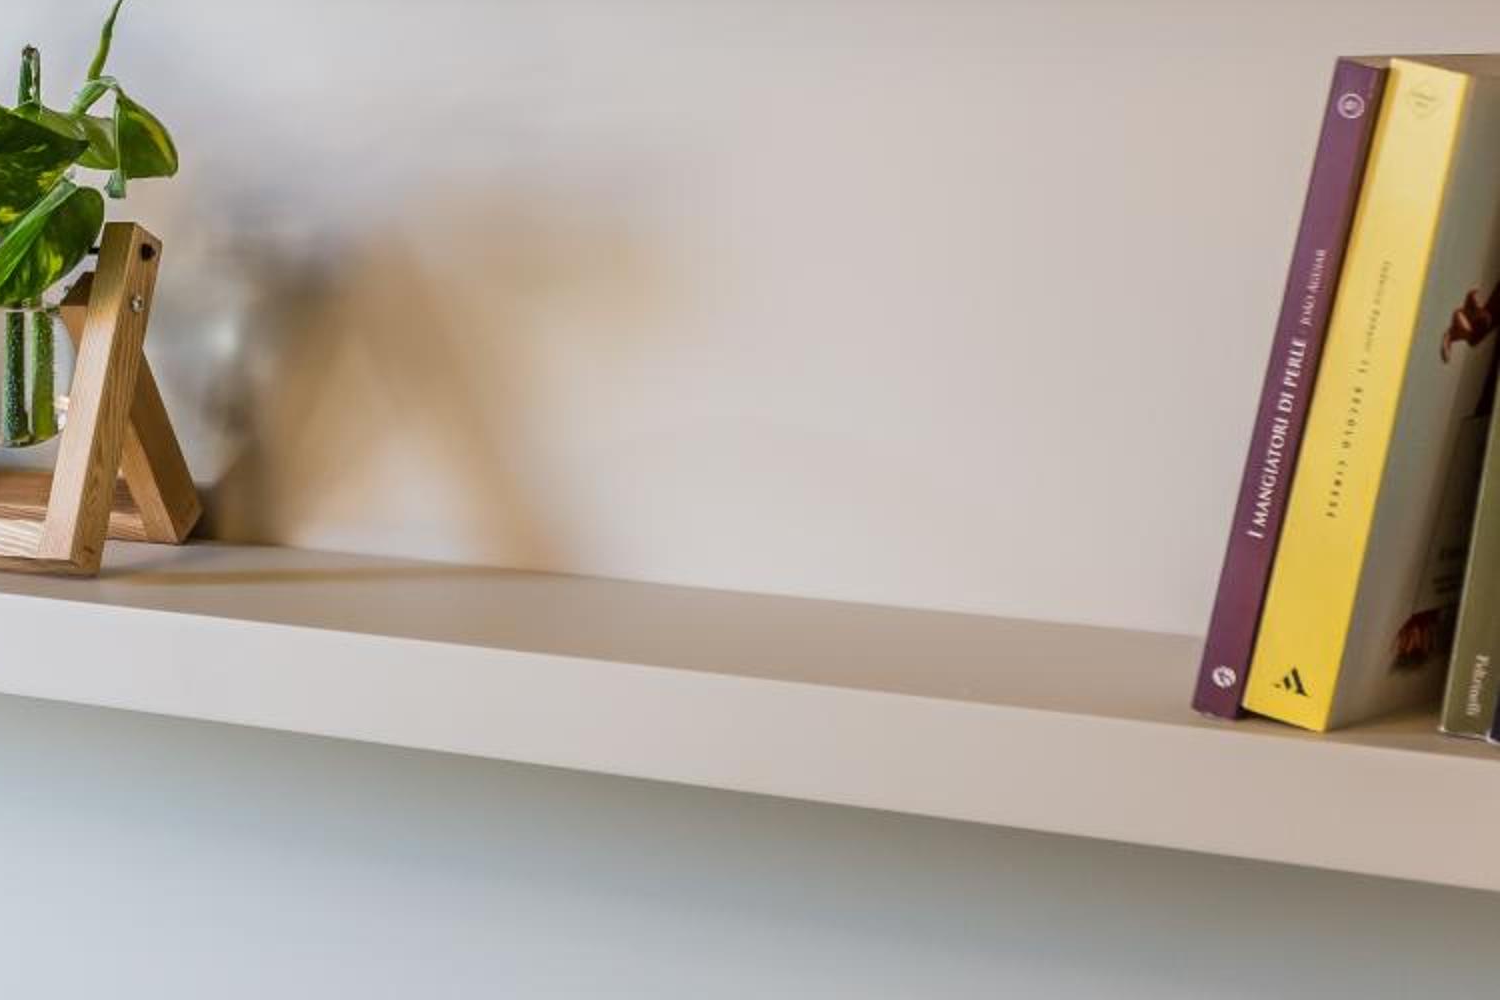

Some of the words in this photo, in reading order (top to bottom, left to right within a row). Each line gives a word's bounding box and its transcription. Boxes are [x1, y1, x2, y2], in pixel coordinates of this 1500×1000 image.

[1282, 338, 1308, 389] PERLE
[1279, 393, 1296, 414] DI
[1251, 417, 1291, 528] MANGIATORI
[1245, 528, 1265, 539] I
